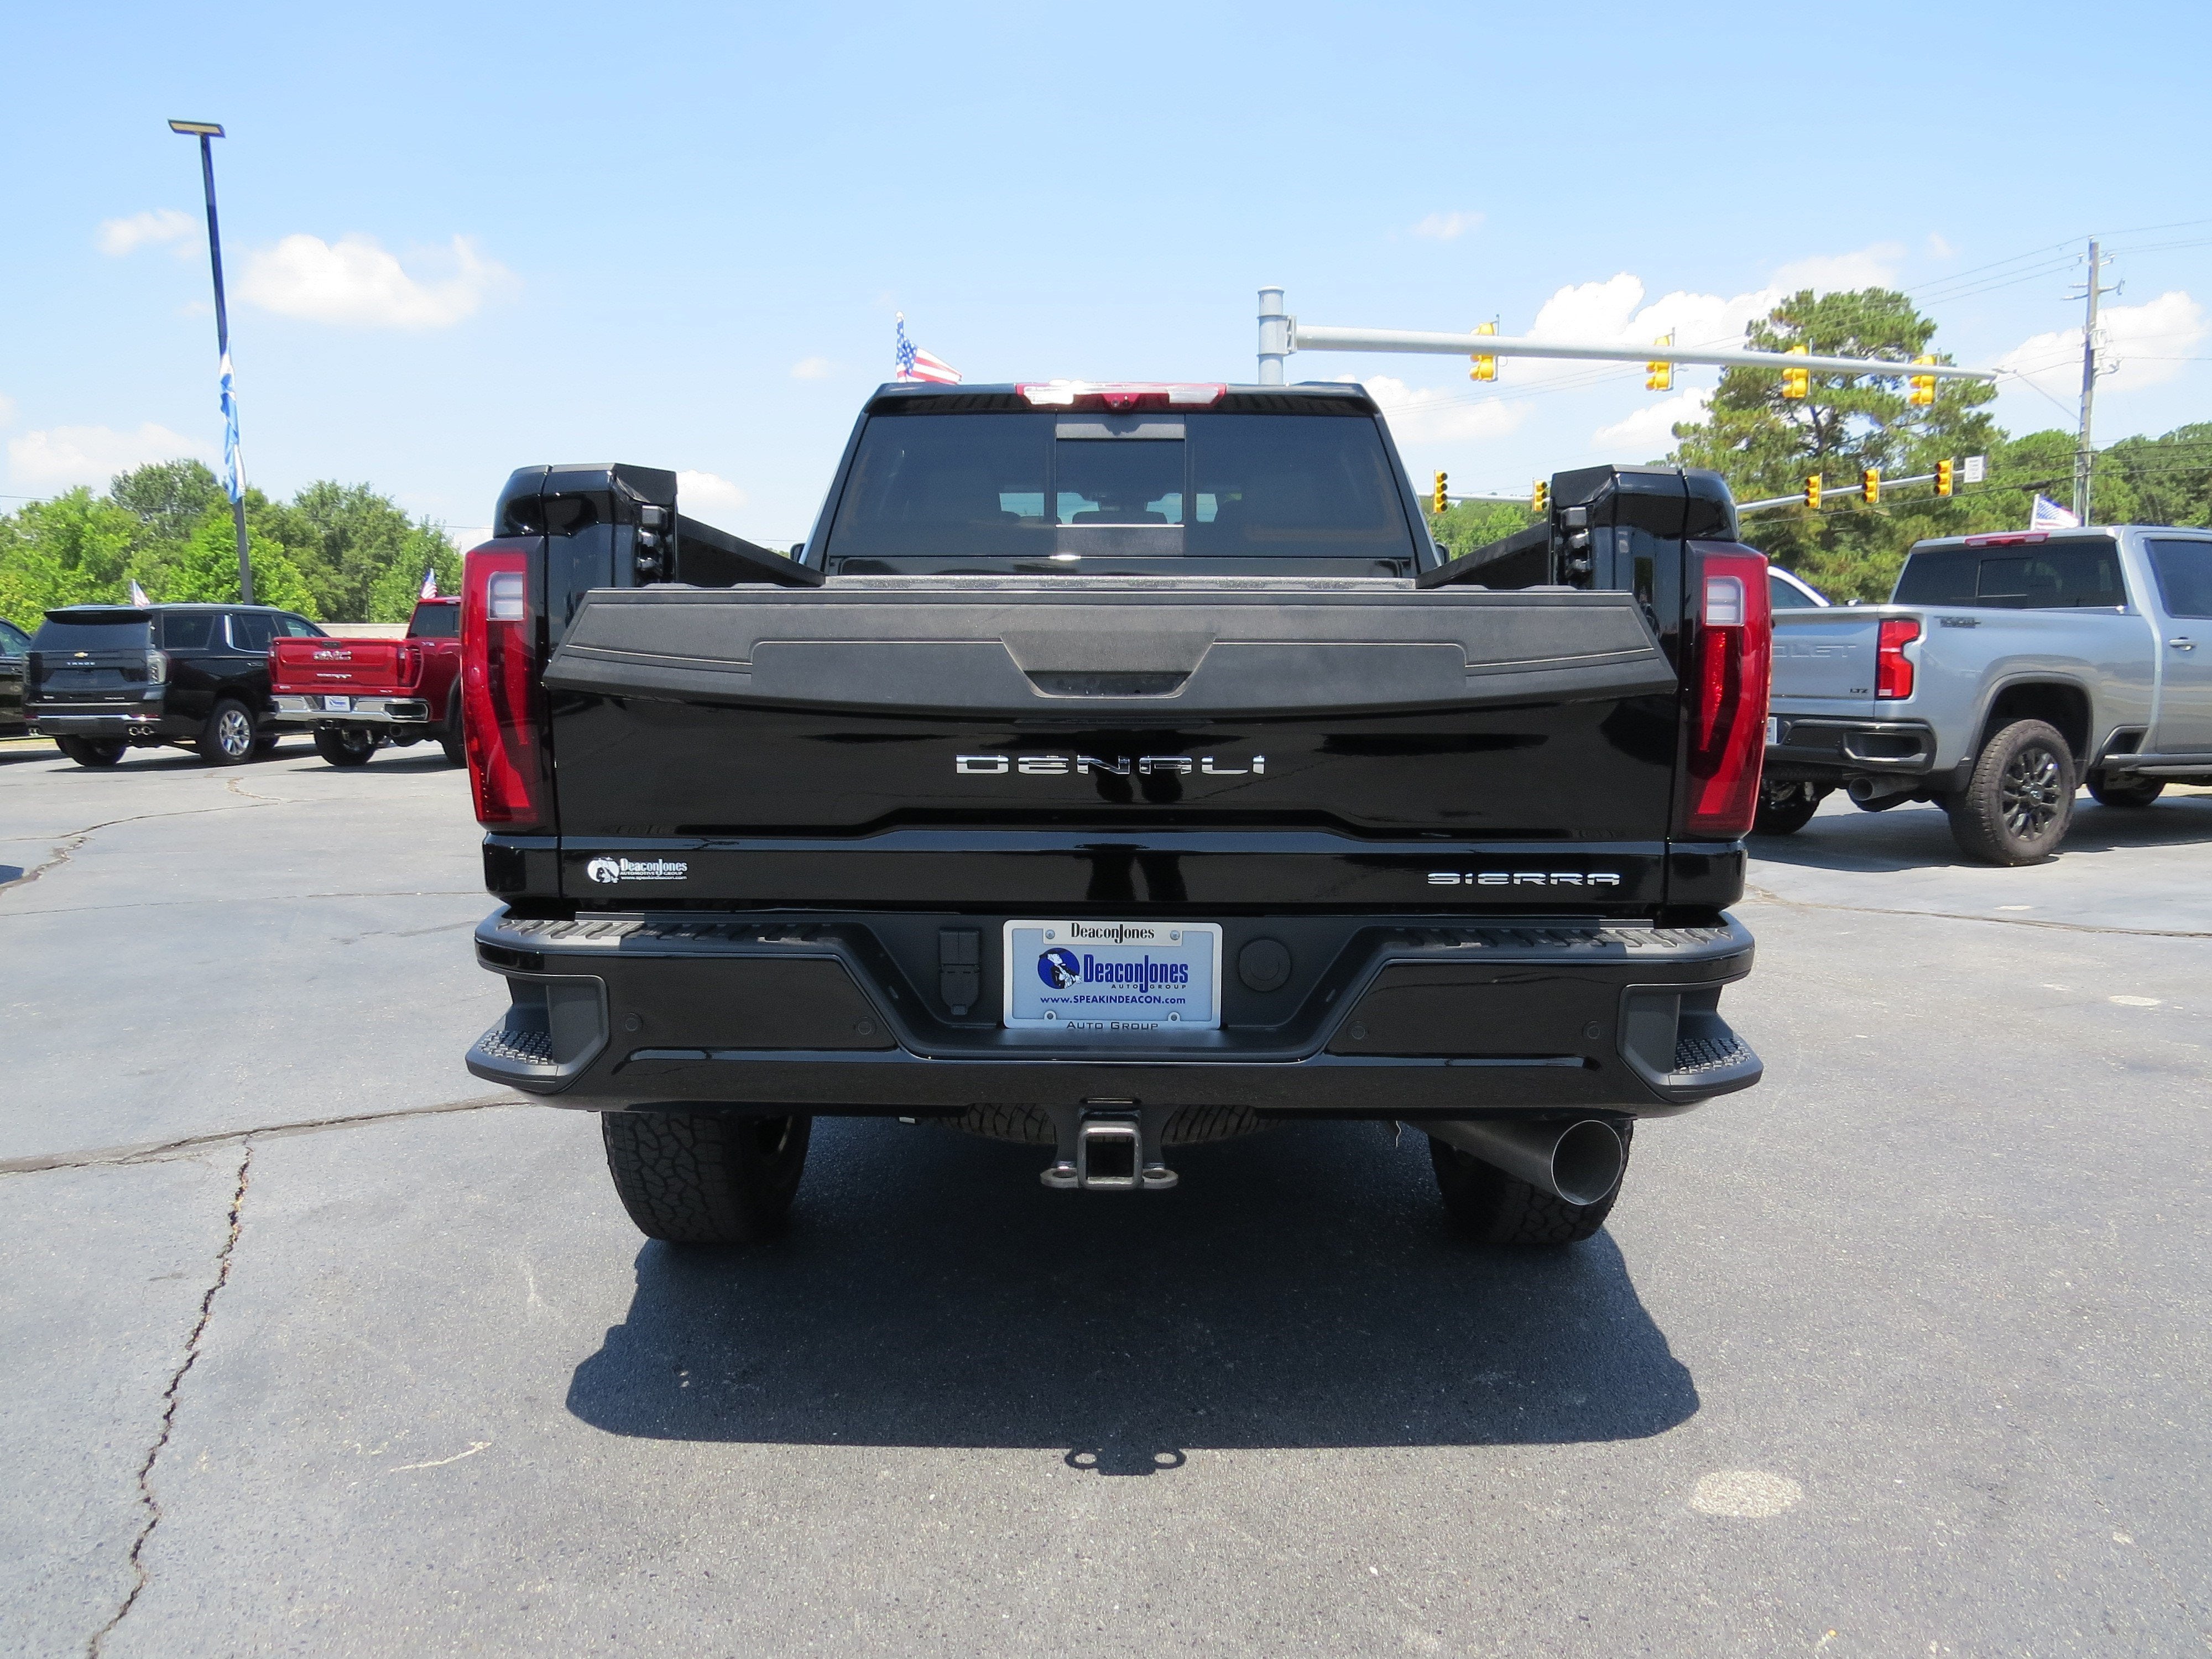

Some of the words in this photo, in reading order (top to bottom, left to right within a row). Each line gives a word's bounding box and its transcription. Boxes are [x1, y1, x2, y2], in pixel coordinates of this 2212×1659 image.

[956, 754, 1266, 775] DENALI
[1427, 872, 1621, 886] SIERRA
[1040, 995, 1186, 1005] www.SPEAKINDEACON.com
